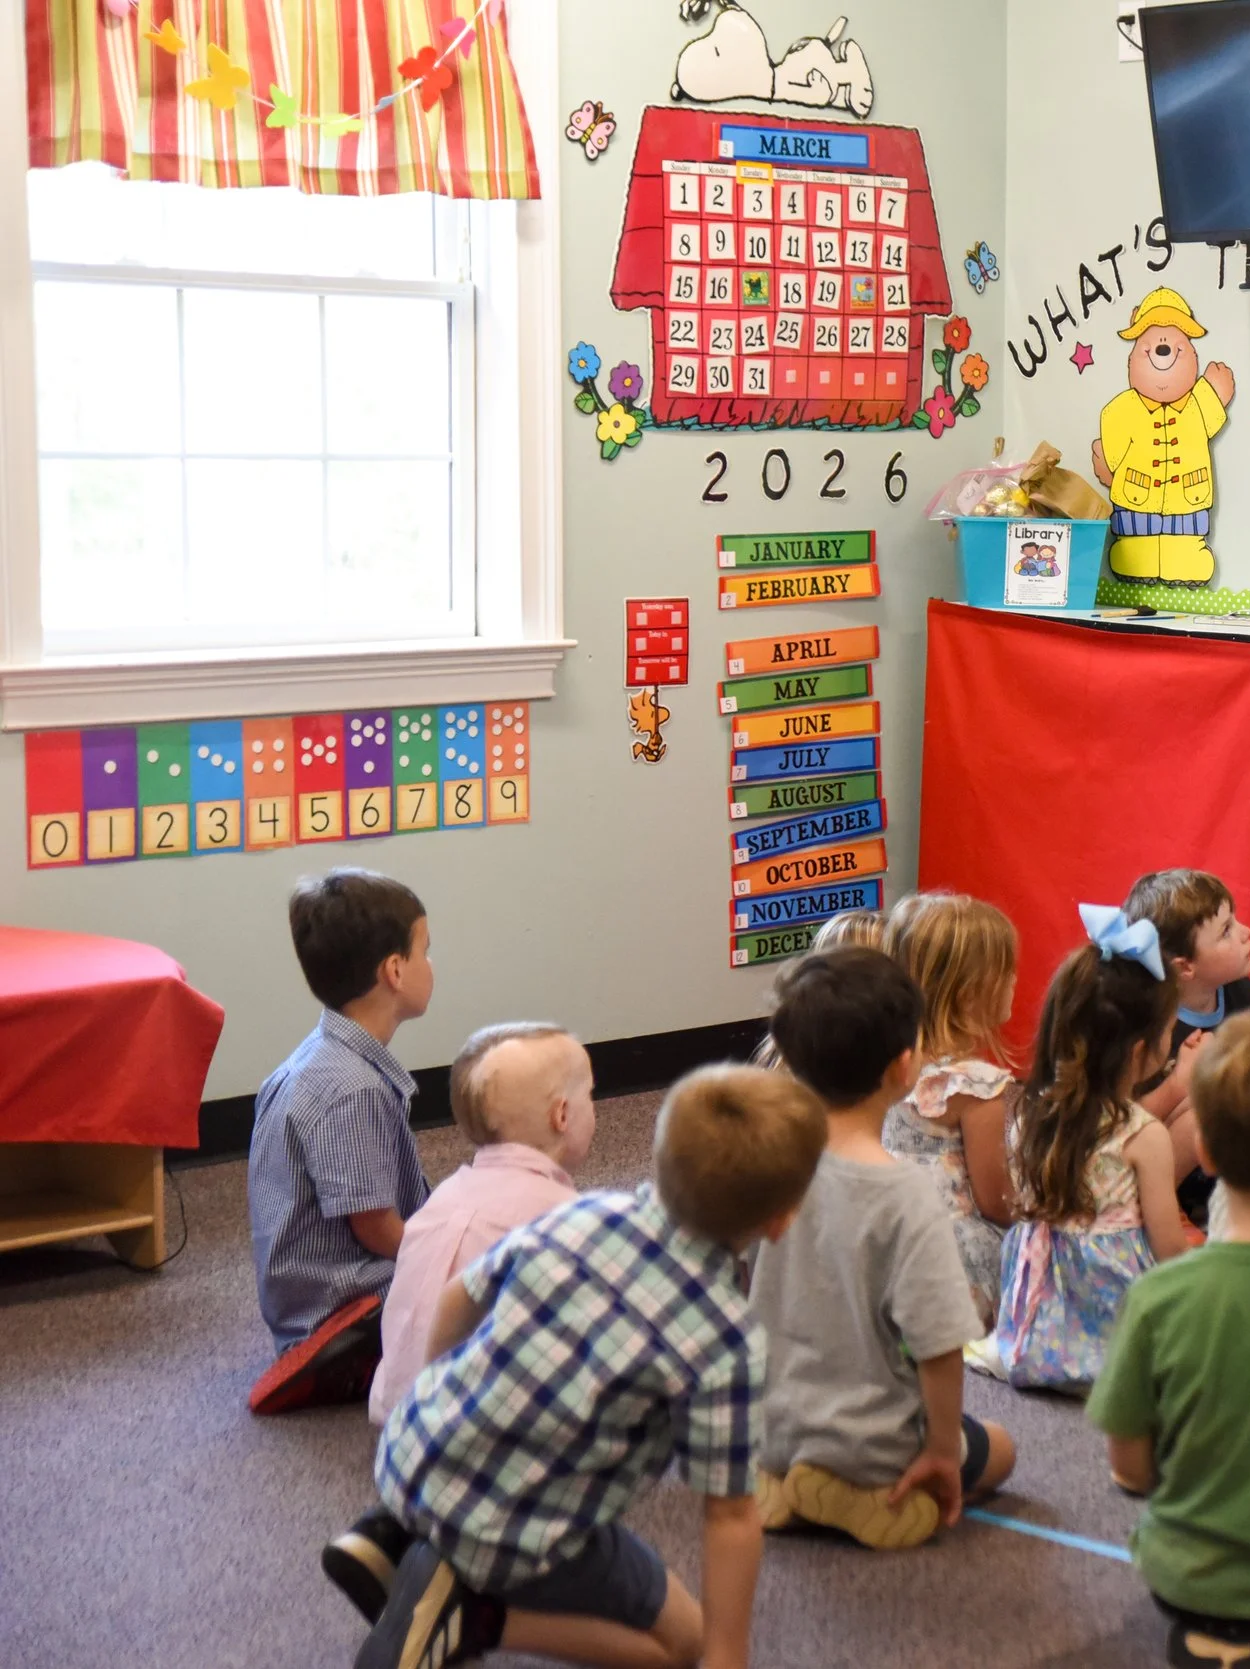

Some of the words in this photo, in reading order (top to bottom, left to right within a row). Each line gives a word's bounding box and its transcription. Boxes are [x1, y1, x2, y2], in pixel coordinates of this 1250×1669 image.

[759, 134, 832, 159] MARCH
[671, 163, 691, 173] Sunday
[707, 165, 729, 175] Monday
[743, 168, 763, 178] Tuesday
[775, 169, 803, 180] Wednesday
[812, 172, 836, 183] Thursday
[849, 175, 865, 185] Friday
[879, 178, 901, 187] Saturday
[681, 183, 688, 205] 1
[713, 185, 724, 206] 2
[752, 190, 763, 212] 3
[787, 192, 797, 213] 4
[825, 200, 834, 221] 5
[857, 192, 867, 213] 6
[888, 198, 898, 219] 7
[680, 234, 691, 256] 8
[715, 230, 726, 251] 9
[749, 237, 766, 258] 10
[786, 235, 800, 257] 11
[817, 241, 836, 263] 12
[850, 240, 868, 262] 13
[884, 245, 902, 267] 14
[675, 276, 693, 298] 15
[709, 278, 728, 299] 16
[784, 282, 802, 303] 18
[818, 281, 836, 302] 19
[888, 284, 905, 305] 21
[1007, 216, 1174, 379] WHAT'S
[671, 320, 694, 342] 22
[713, 327, 732, 349] 23
[745, 324, 765, 346] 24
[777, 320, 798, 343] 25
[817, 325, 838, 347] 26
[851, 326, 871, 347] 27
[884, 325, 907, 346] 28
[671, 364, 695, 387] 29
[710, 366, 729, 388] 30
[748, 368, 765, 390] 31
[701, 449, 908, 502] 2026
[1015, 527, 1064, 542] Library
[750, 540, 846, 562] JANUARY
[746, 573, 851, 601] FEBRUARY
[648, 630, 662, 638] Today
[771, 638, 836, 663] APRIL
[773, 677, 820, 700] MAY
[779, 714, 831, 737] JUNE
[778, 748, 830, 770] JULY
[768, 782, 847, 808] AUGUST
[43, 820, 69, 858] 0
[109, 816, 114, 853] 1
[156, 812, 175, 849] 2
[208, 807, 228, 843] 3
[259, 803, 279, 838] 4
[311, 797, 329, 832] 5
[361, 793, 379, 827] 6
[409, 788, 426, 823] 7
[455, 784, 472, 818] 8
[501, 780, 517, 813] 9
[746, 809, 872, 855] SEPTEMBER
[766, 852, 857, 885] OCTOBER
[751, 889, 866, 923] NOVEMBER
